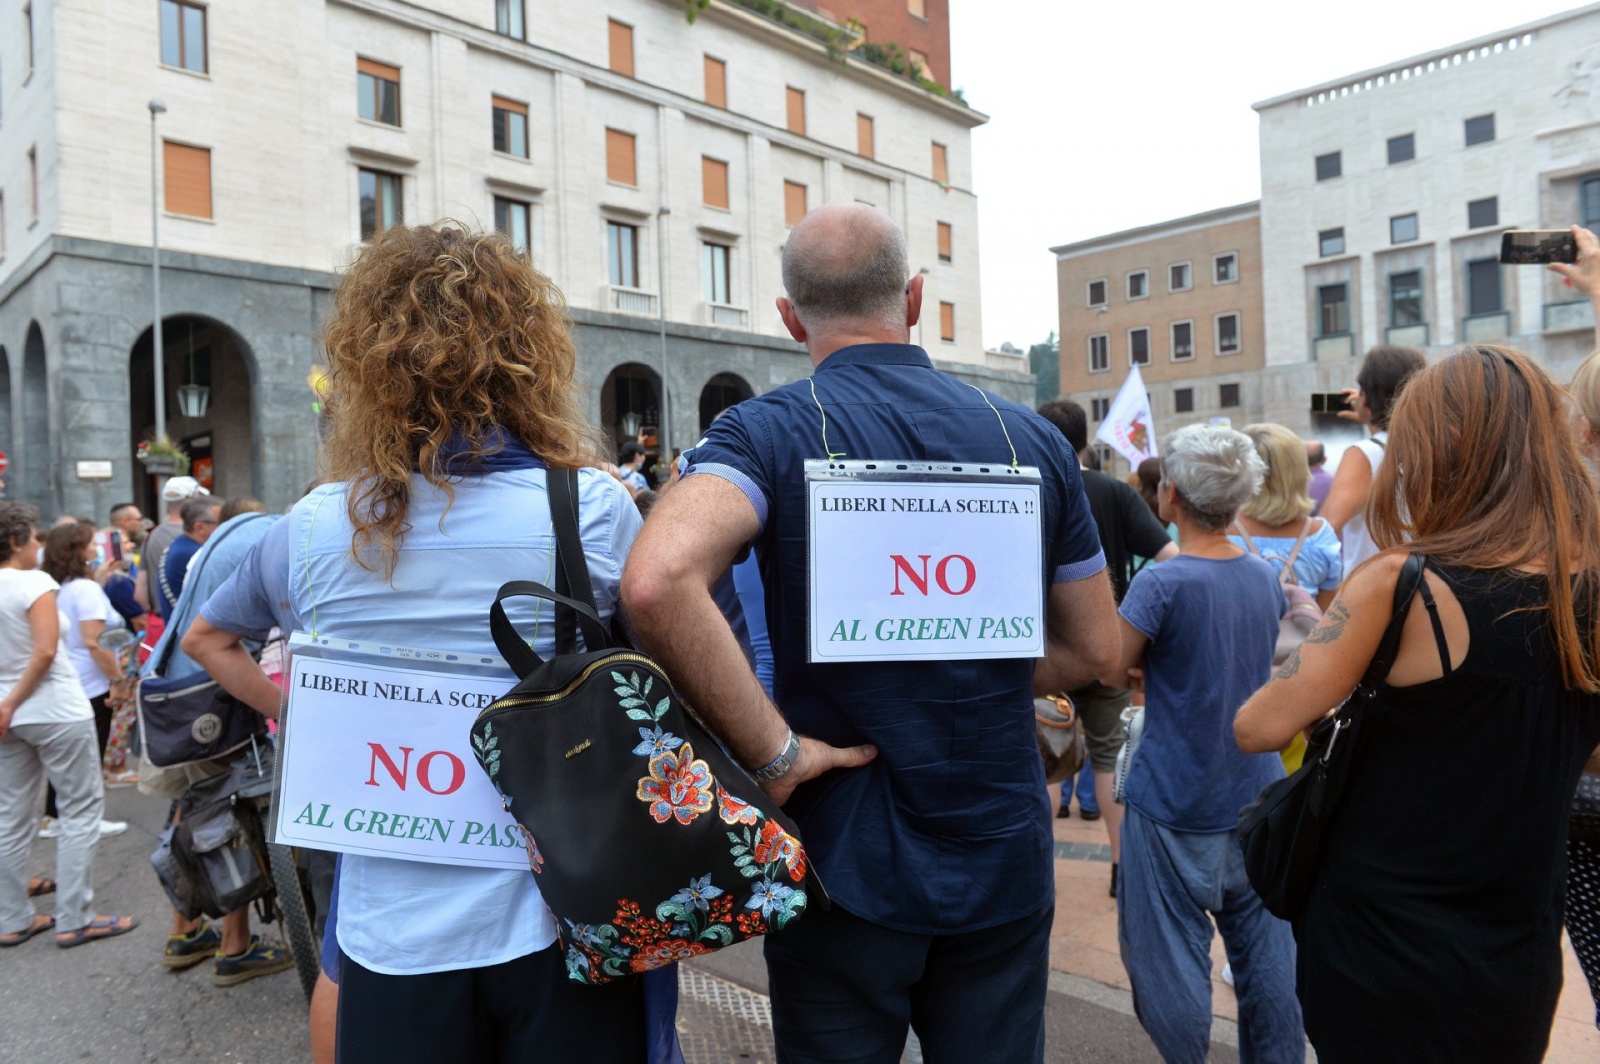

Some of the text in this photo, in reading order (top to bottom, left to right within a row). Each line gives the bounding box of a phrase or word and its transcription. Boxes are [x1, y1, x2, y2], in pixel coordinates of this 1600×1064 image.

[820, 497, 1034, 514] LIBERI NELLA SCELTA !!
[889, 554, 977, 596] NO
[828, 616, 1035, 643] AL GREEN PASS
[300, 672, 368, 696] LIBERI
[373, 682, 443, 706] NELLA
[364, 742, 466, 795] NO
[293, 800, 336, 829] AL
[343, 803, 454, 844] GREEN
